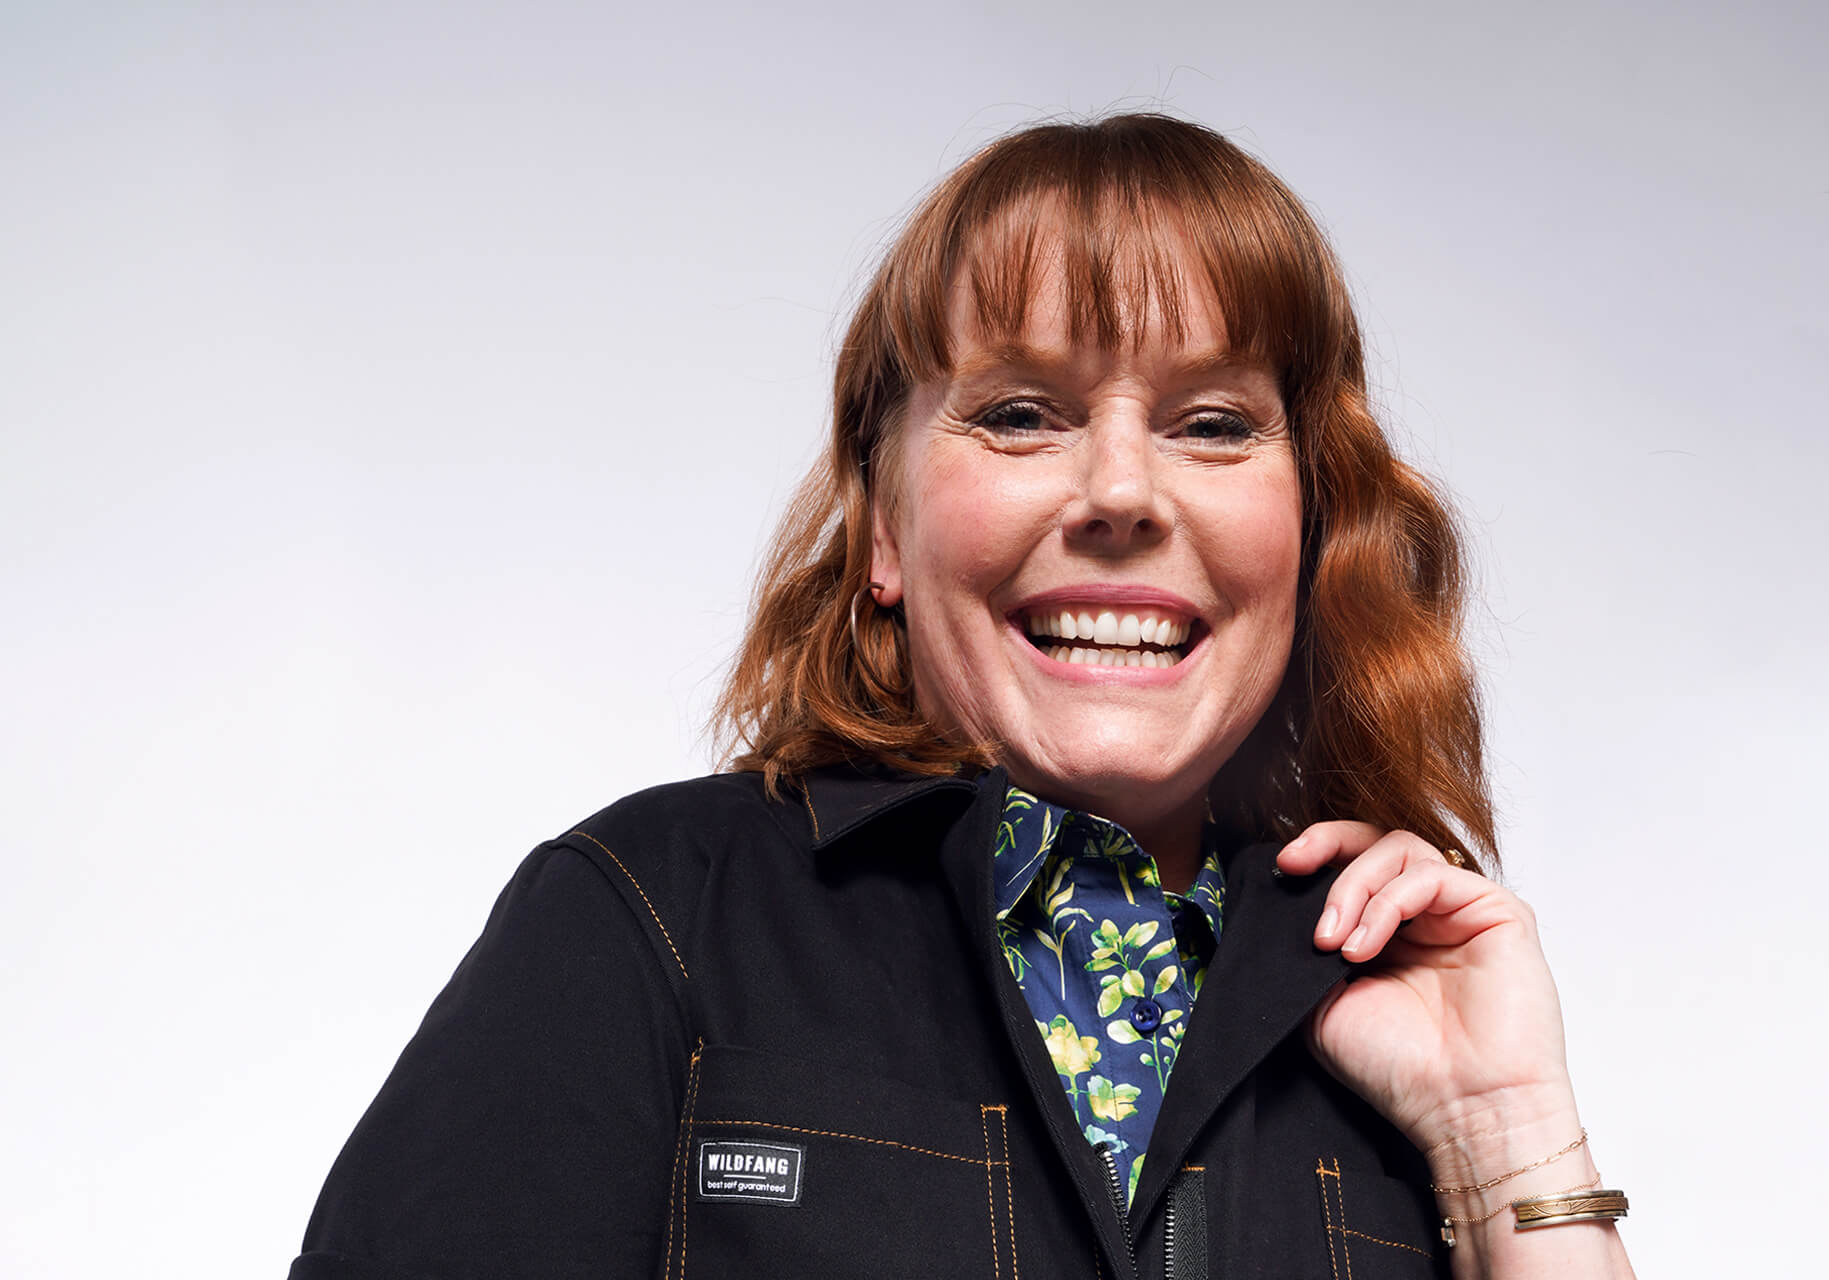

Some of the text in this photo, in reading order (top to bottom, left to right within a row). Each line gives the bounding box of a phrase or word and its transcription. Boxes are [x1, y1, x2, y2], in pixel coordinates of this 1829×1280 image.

[708, 1154, 789, 1175] WILDFANG
[707, 1180, 723, 1189] best
[738, 1182, 786, 1193] guaranteed
